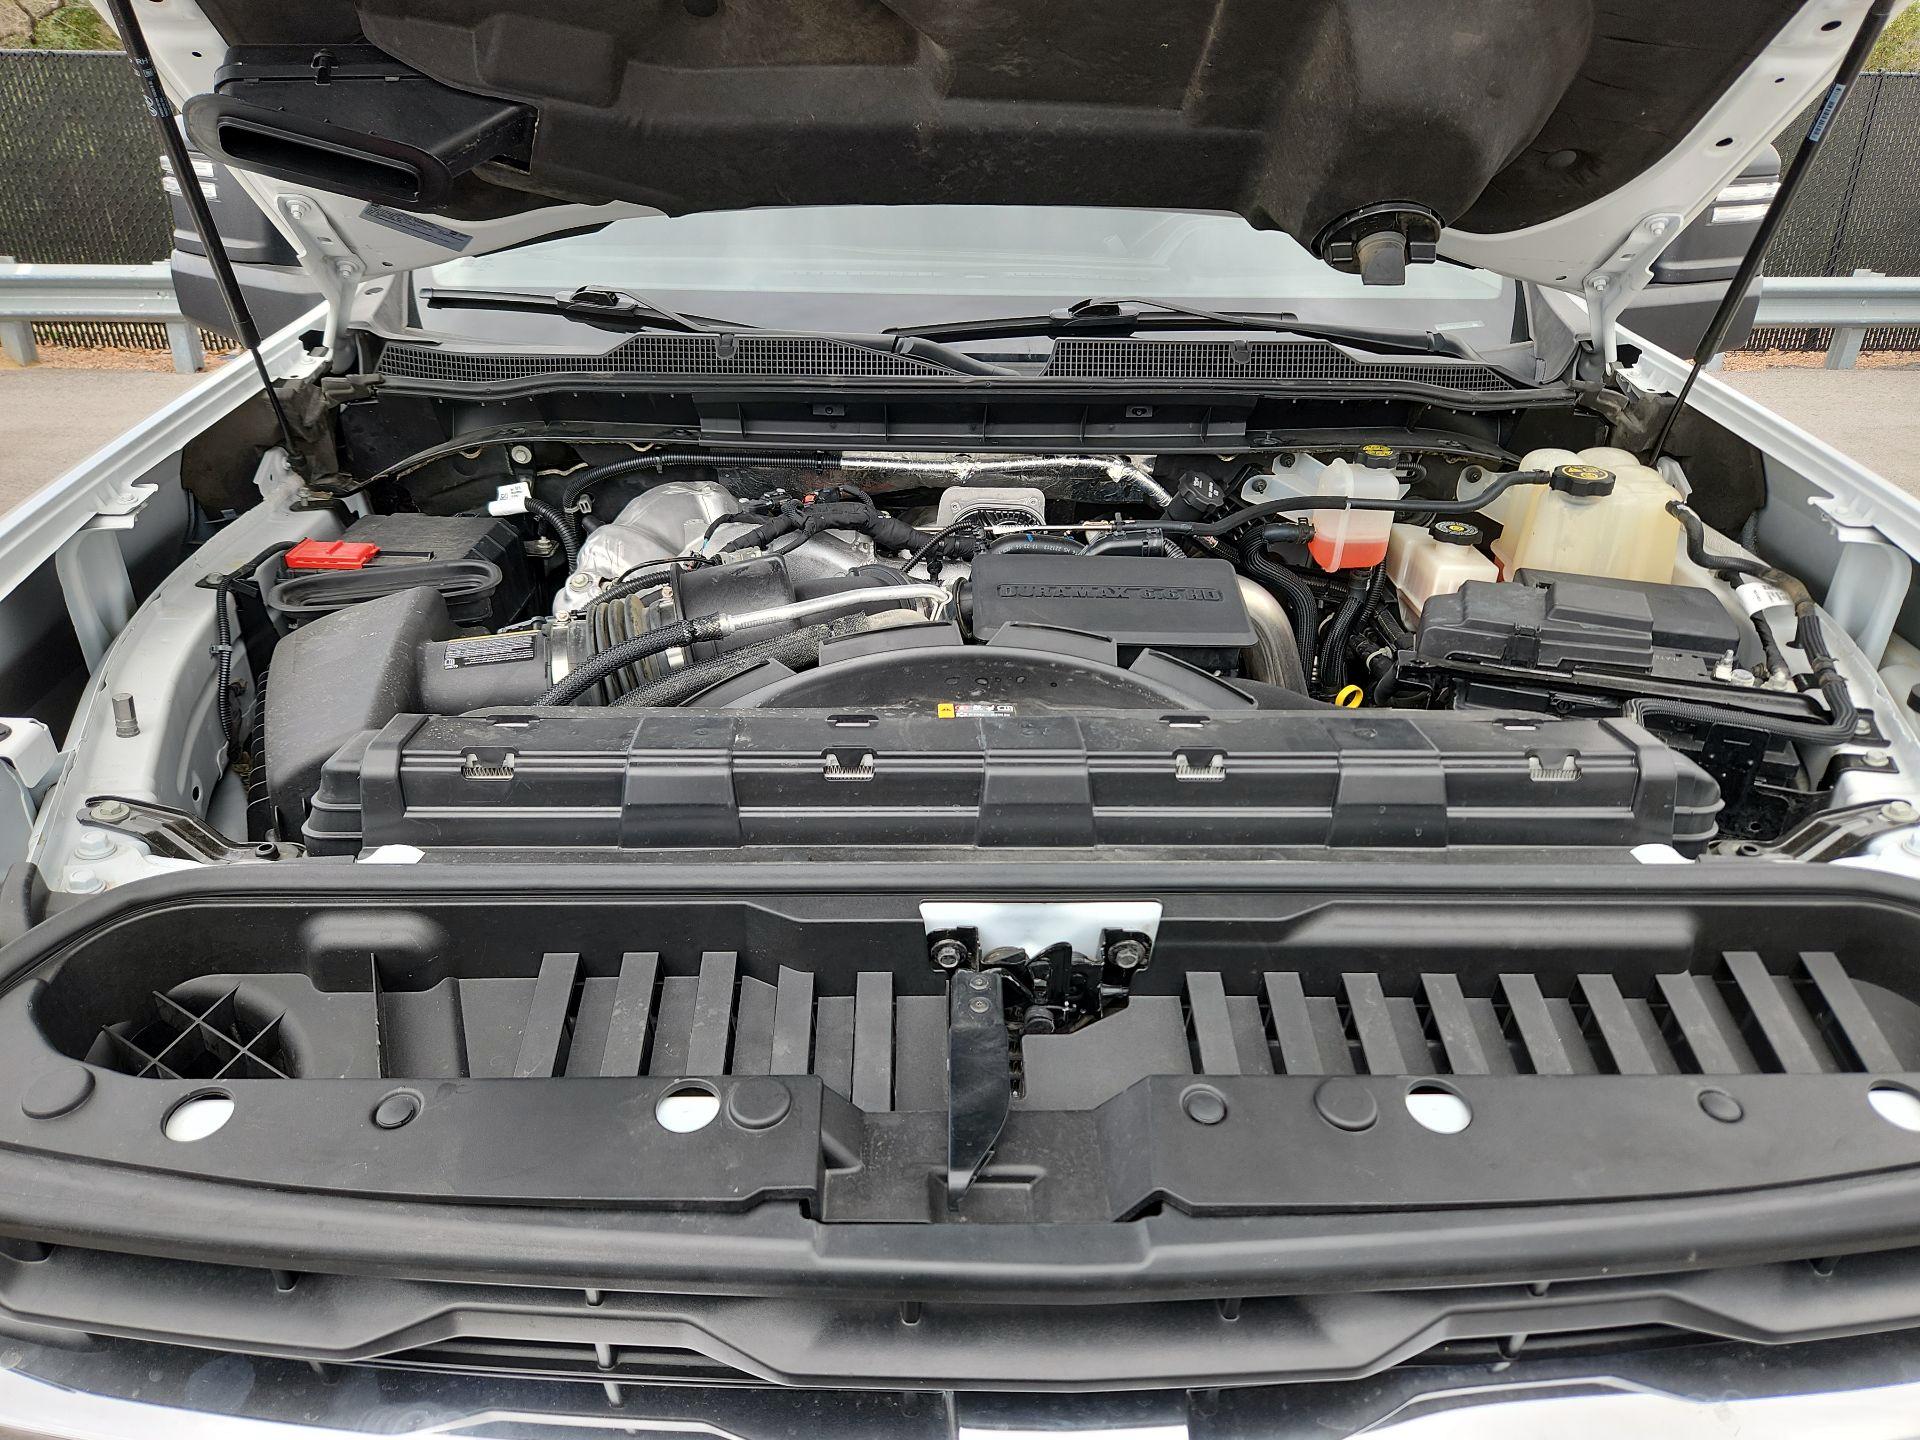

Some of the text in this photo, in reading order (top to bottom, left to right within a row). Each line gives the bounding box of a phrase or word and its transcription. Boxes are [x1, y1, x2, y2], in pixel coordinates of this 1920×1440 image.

[134, 56, 149, 65] RH
[999, 584, 1222, 602] DURAMAX 6.6 HD
